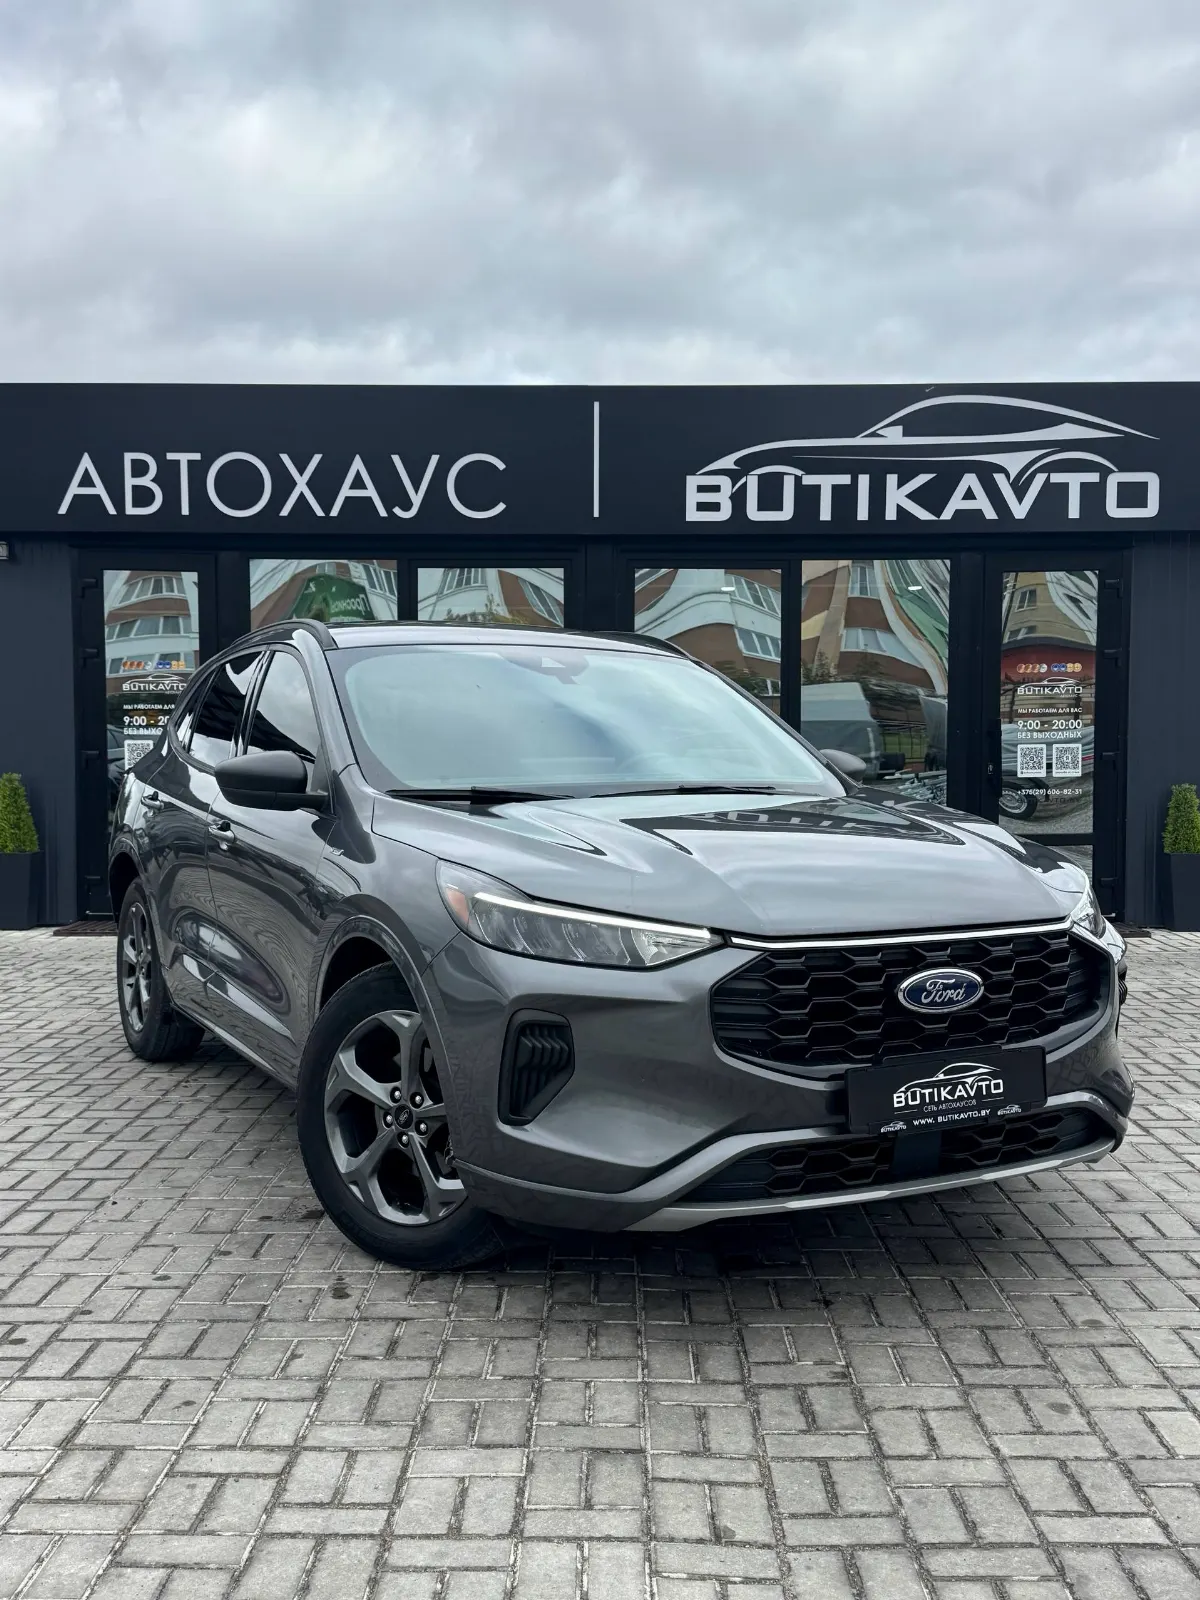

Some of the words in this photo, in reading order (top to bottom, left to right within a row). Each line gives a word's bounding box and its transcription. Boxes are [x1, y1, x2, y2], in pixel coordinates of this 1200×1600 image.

[57, 451, 507, 519] АВТОХАУС
[685, 471, 1160, 522] BUTIKAVTO
[1017, 686, 1083, 695] BUTIKAVTO
[123, 716, 147, 726] 9:00
[1017, 720, 1041, 730] 9:00
[1052, 719, 1083, 730] 20:00
[139, 727, 164, 735] ВЫХО
[1017, 731, 1031, 739] БЕЗ
[1033, 731, 1082, 739] ВЫХОДНЫХ
[921, 978, 967, 1004] Ford
[893, 1078, 1004, 1108] BUTIKAVTO
[923, 1103, 938, 1113] СЕТЬ
[938, 1099, 977, 1111] АВТОХАУСОВ
[937, 1108, 991, 1123] BUTIKAVTO.BY
